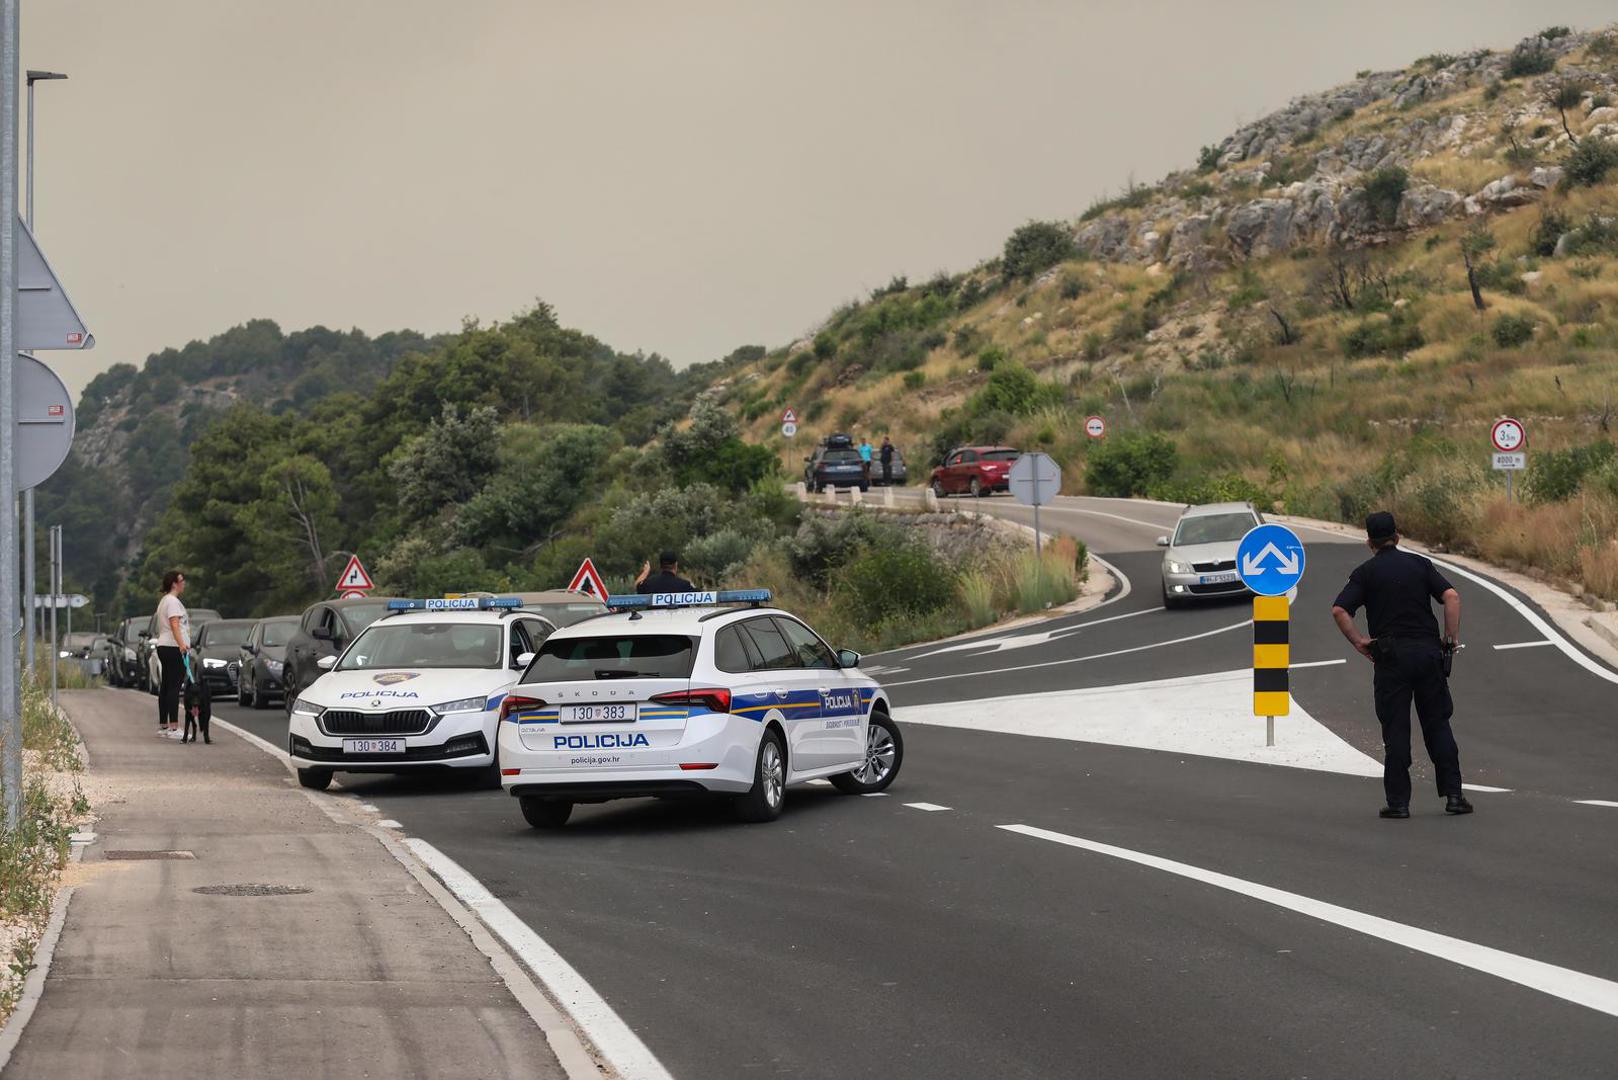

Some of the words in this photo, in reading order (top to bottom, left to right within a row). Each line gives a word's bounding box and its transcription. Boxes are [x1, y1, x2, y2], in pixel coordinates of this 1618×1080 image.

[428, 599, 476, 608] POLICIJA
[655, 593, 712, 604] POLICIJA
[340, 690, 419, 699] POLICIJA
[825, 695, 852, 709] POLICIJA
[572, 707, 593, 721] 130
[603, 705, 625, 719] 383
[353, 741, 370, 751] 130
[378, 741, 397, 752] 384
[553, 733, 650, 749] POLICIJA
[571, 756, 620, 765] policija.gov.hr
